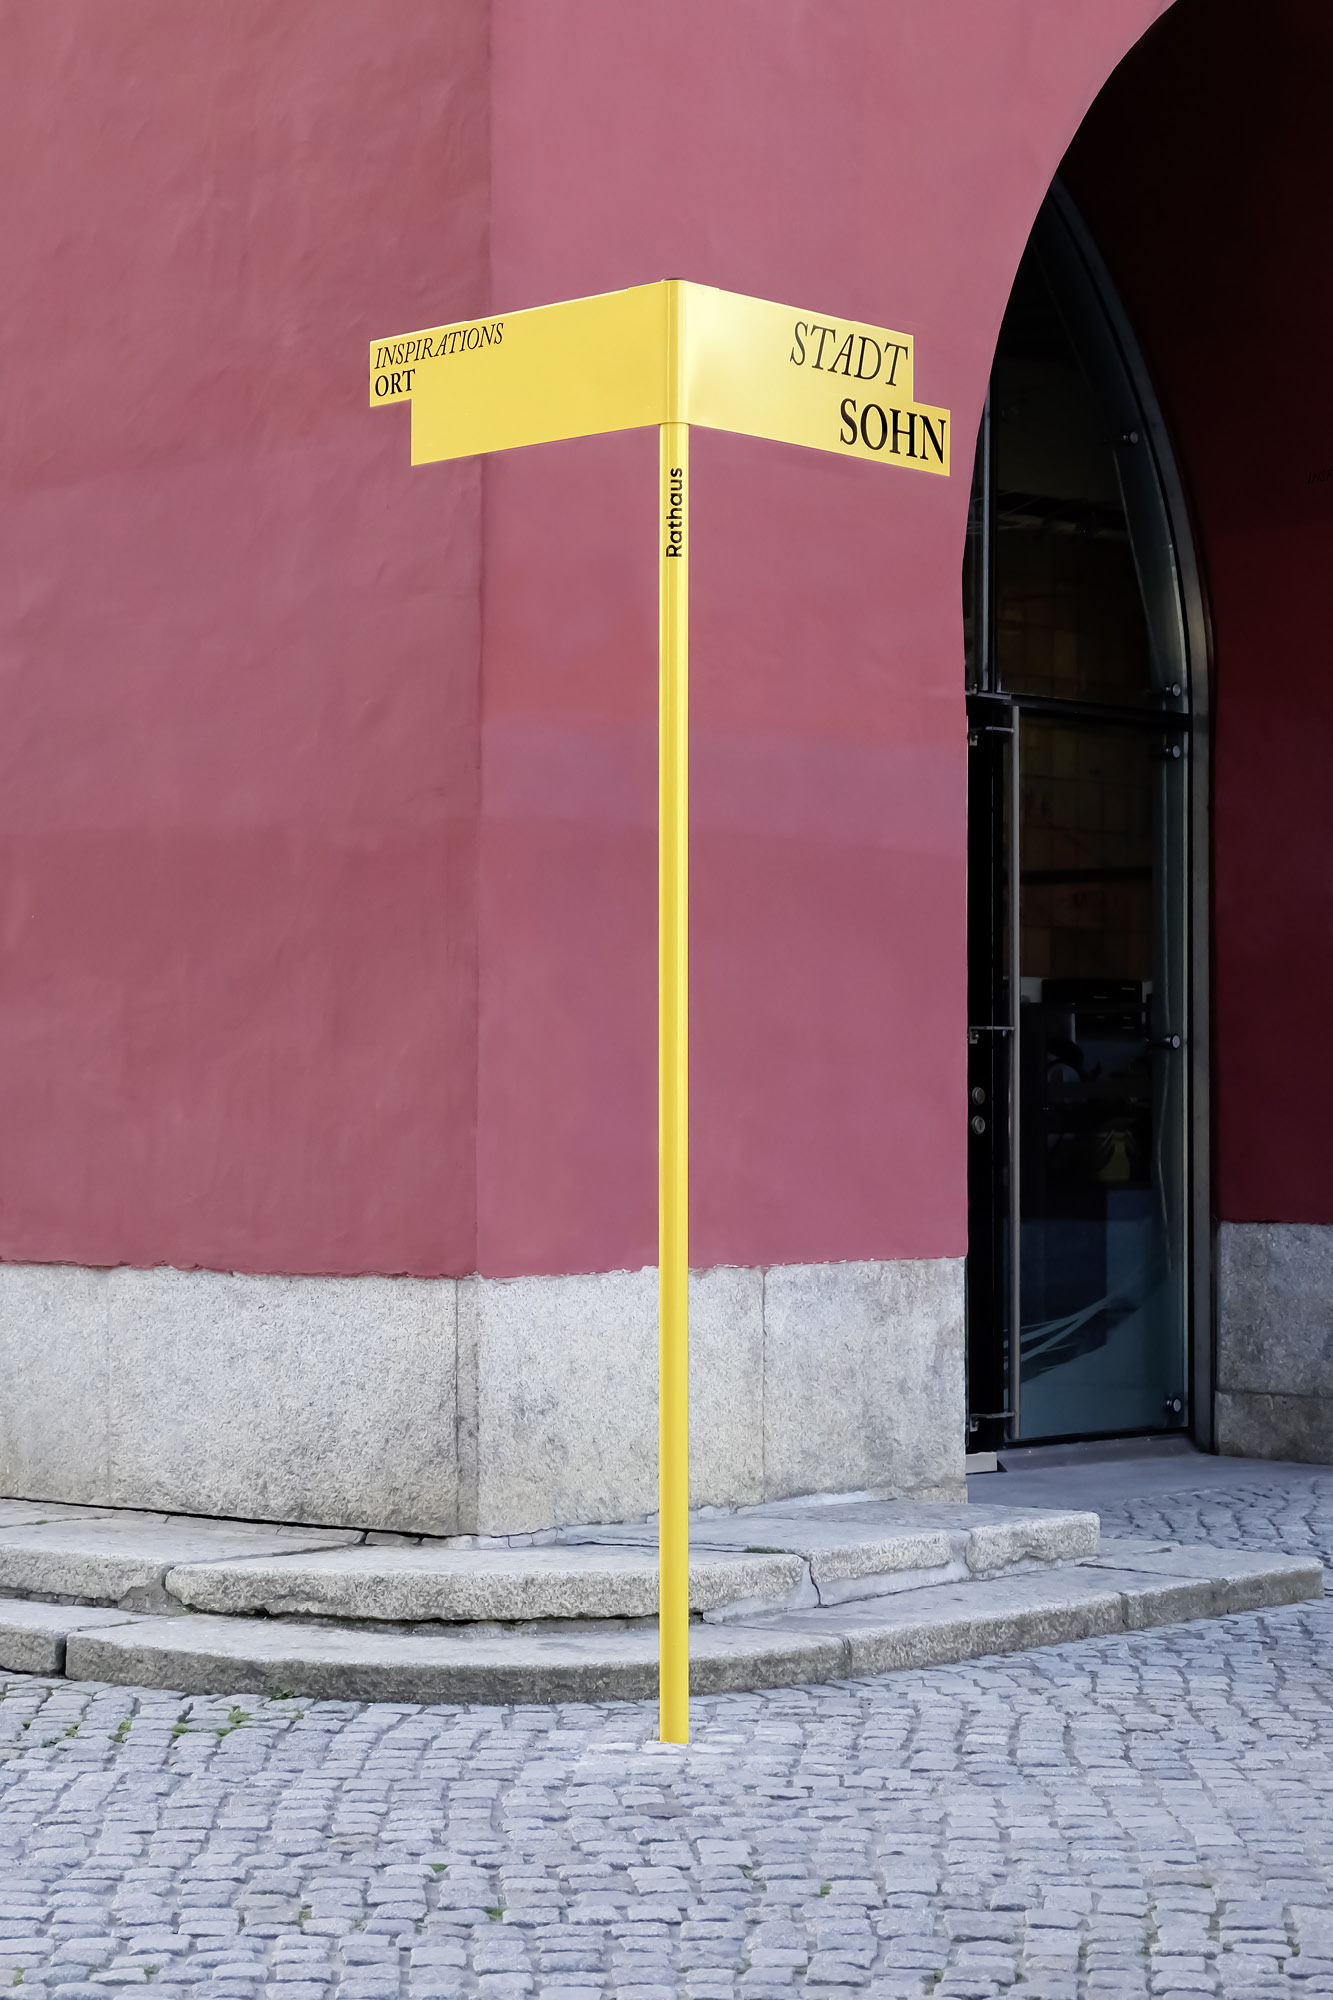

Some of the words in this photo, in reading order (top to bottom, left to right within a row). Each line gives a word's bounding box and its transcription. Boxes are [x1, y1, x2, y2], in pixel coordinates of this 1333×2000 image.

[374, 323, 504, 369] INSPIRATIONS
[789, 321, 909, 386] STADT
[375, 369, 415, 397] ORT
[840, 398, 946, 464] SOHN
[666, 468, 683, 557] Rathaus
